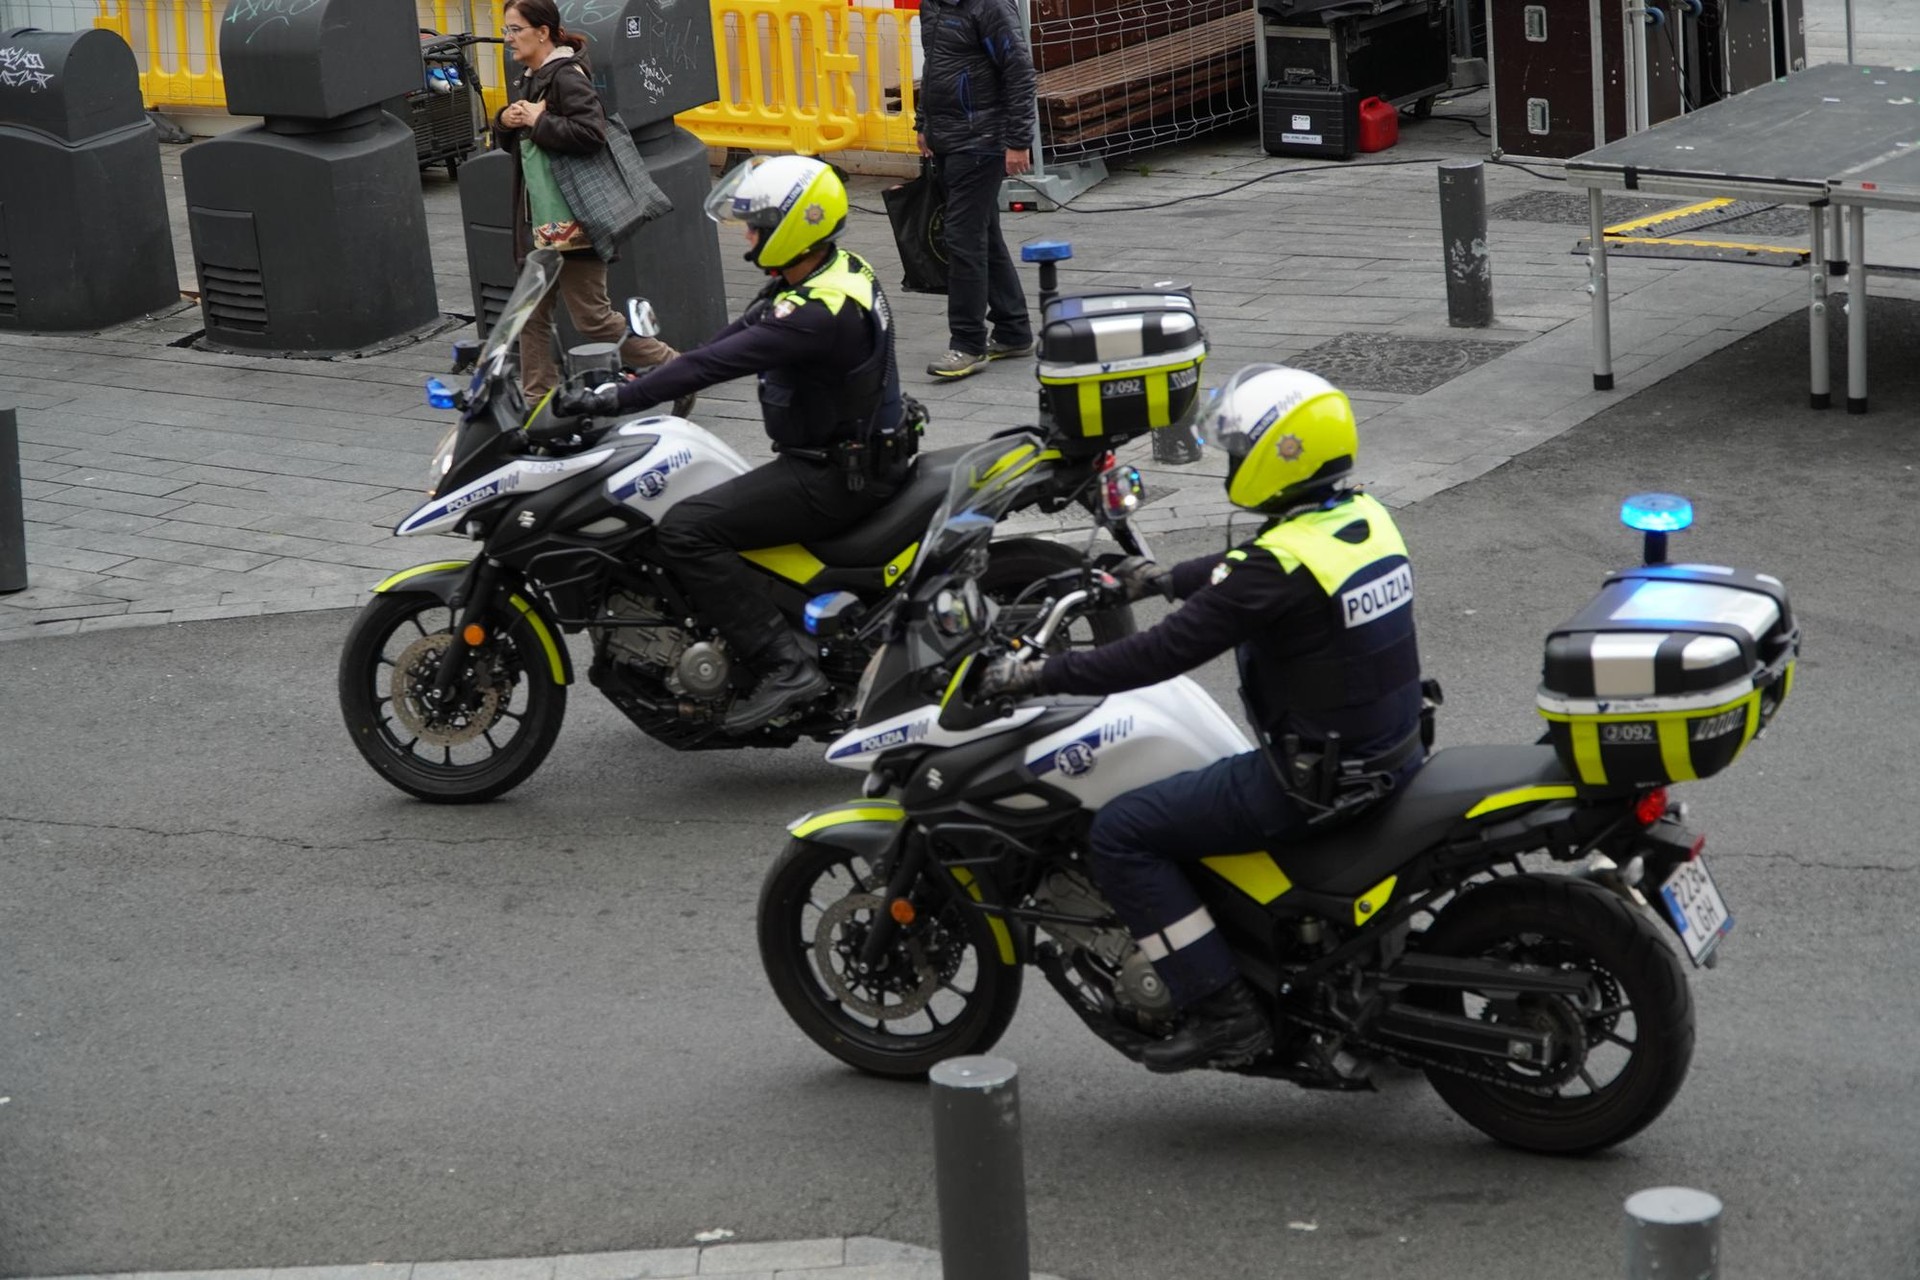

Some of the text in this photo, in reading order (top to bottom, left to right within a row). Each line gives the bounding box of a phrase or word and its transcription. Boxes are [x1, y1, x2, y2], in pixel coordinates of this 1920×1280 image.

[446, 485, 496, 513] POLIZIA
[1346, 572, 1410, 622] POLIZIA
[860, 729, 905, 753] POLIZIA
